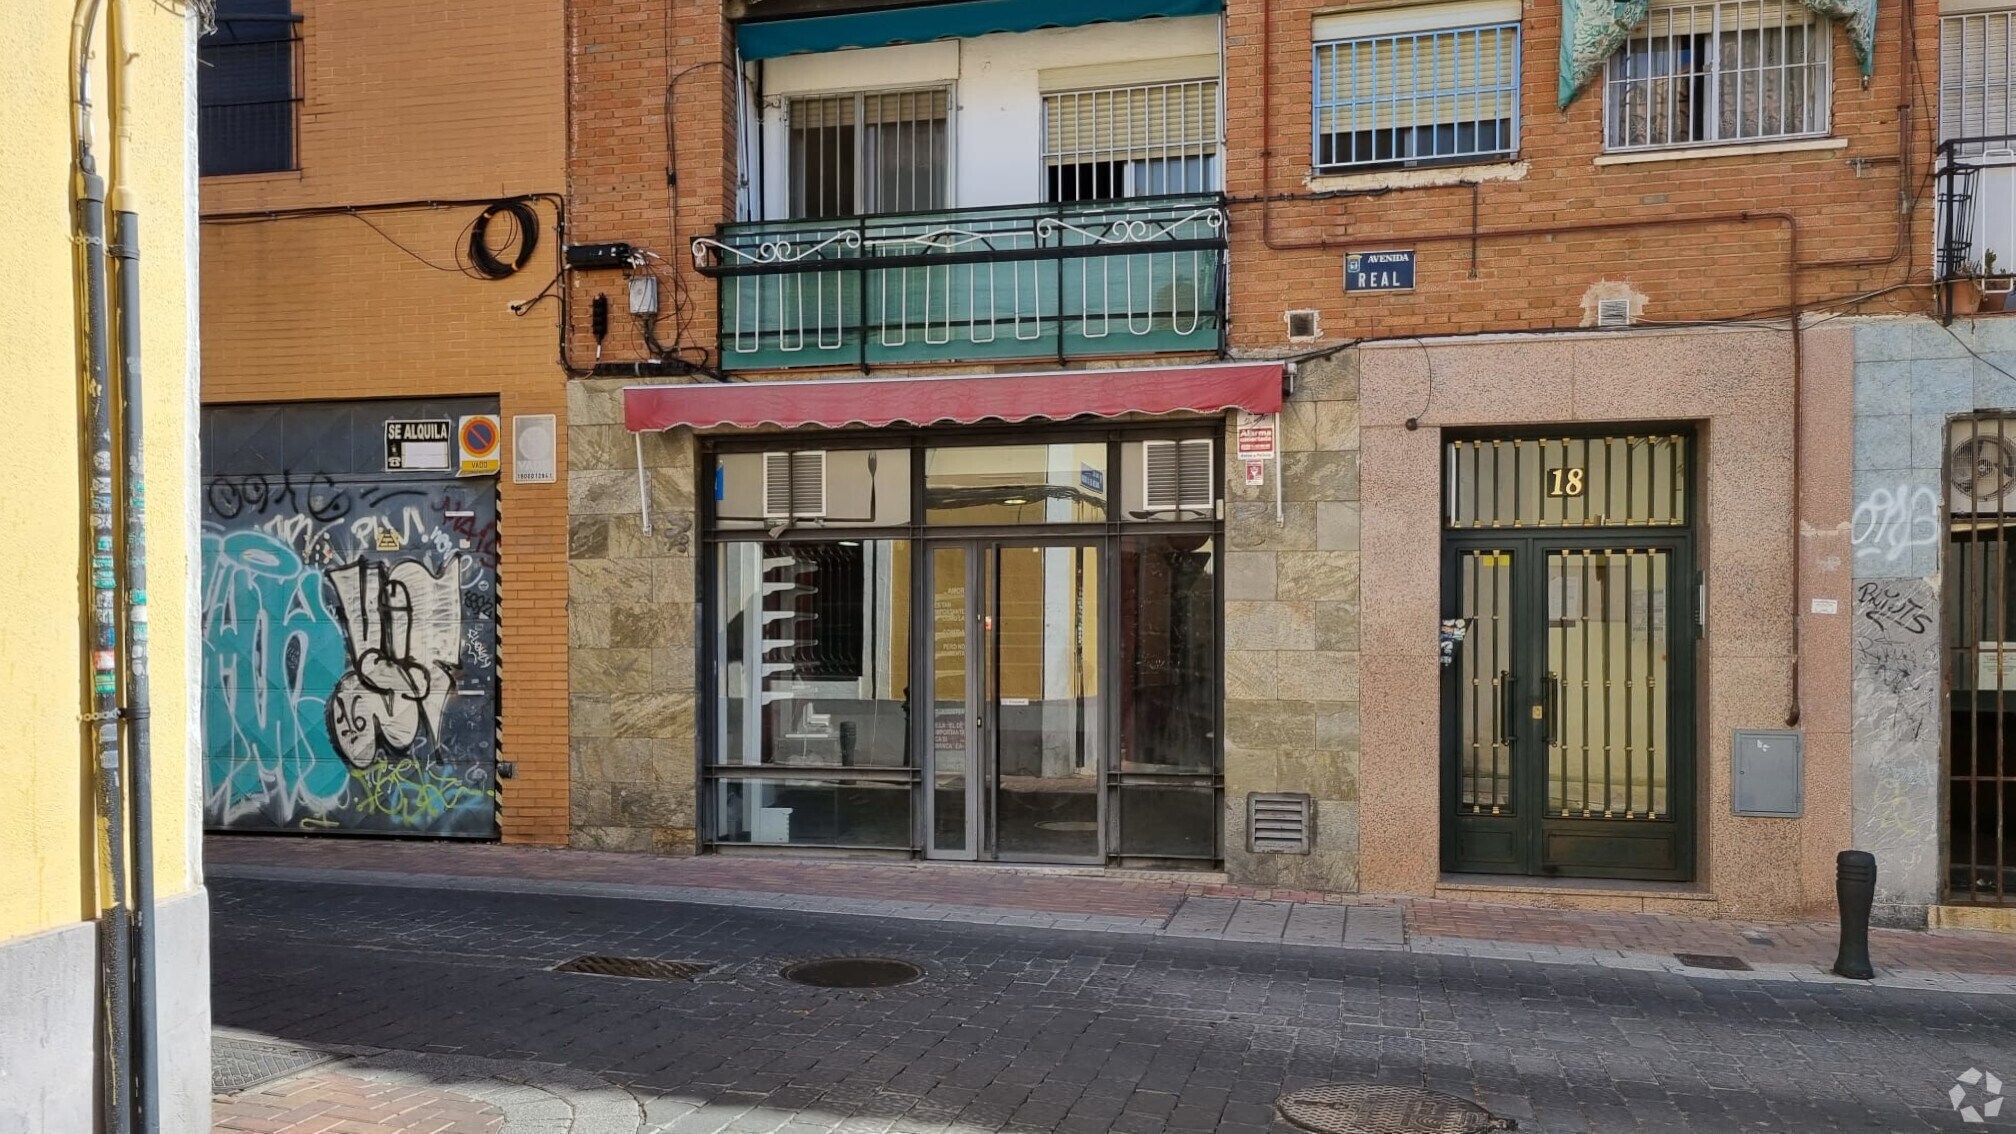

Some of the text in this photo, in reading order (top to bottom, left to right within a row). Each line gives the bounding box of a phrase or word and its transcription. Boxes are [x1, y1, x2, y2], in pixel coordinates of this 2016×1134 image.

[1368, 254, 1409, 263] AVENIDA
[1358, 271, 1400, 287] REAL
[388, 424, 448, 440] SE ALQUILA
[1550, 468, 1583, 496] 18
